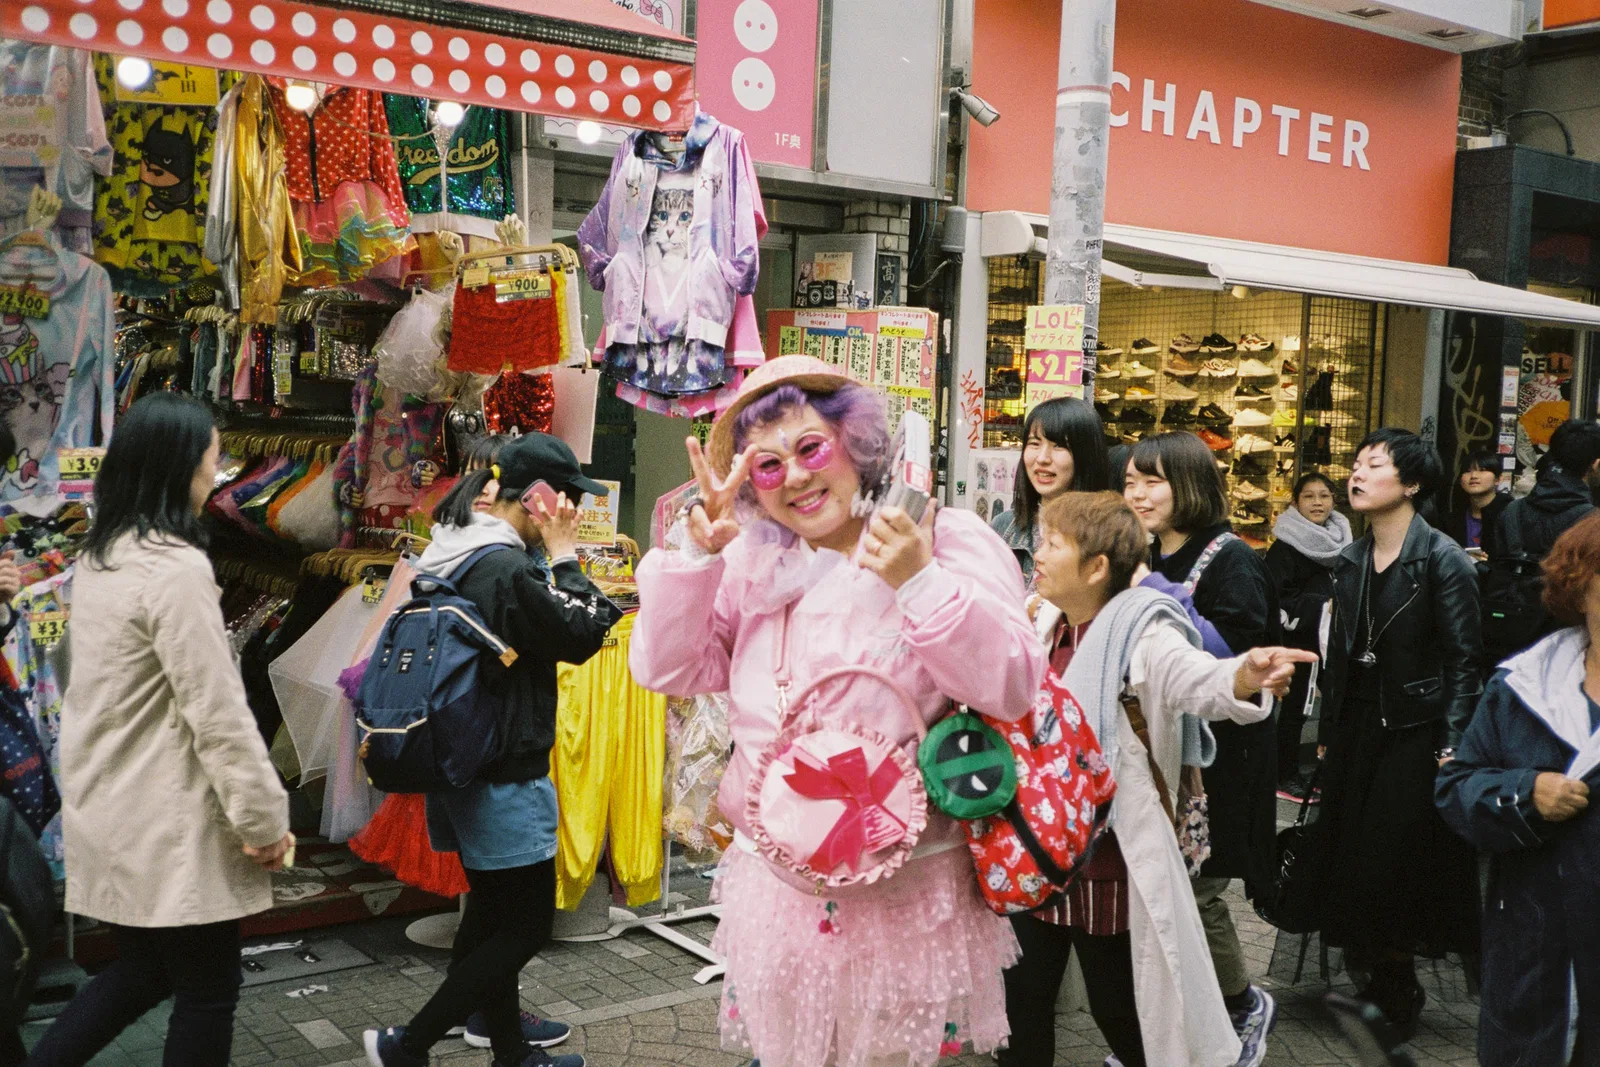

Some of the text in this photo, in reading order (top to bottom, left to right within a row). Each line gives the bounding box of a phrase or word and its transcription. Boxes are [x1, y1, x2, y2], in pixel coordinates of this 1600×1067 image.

[1109, 70, 1370, 171] CHAPTER
[774, 132, 801, 149] 1F奥
[509, 278, 539, 291] ¥900
[1034, 309, 1077, 330] LOL
[847, 328, 863, 337] OK
[1044, 353, 1081, 382] 2F
[1521, 357, 1569, 374] SELL
